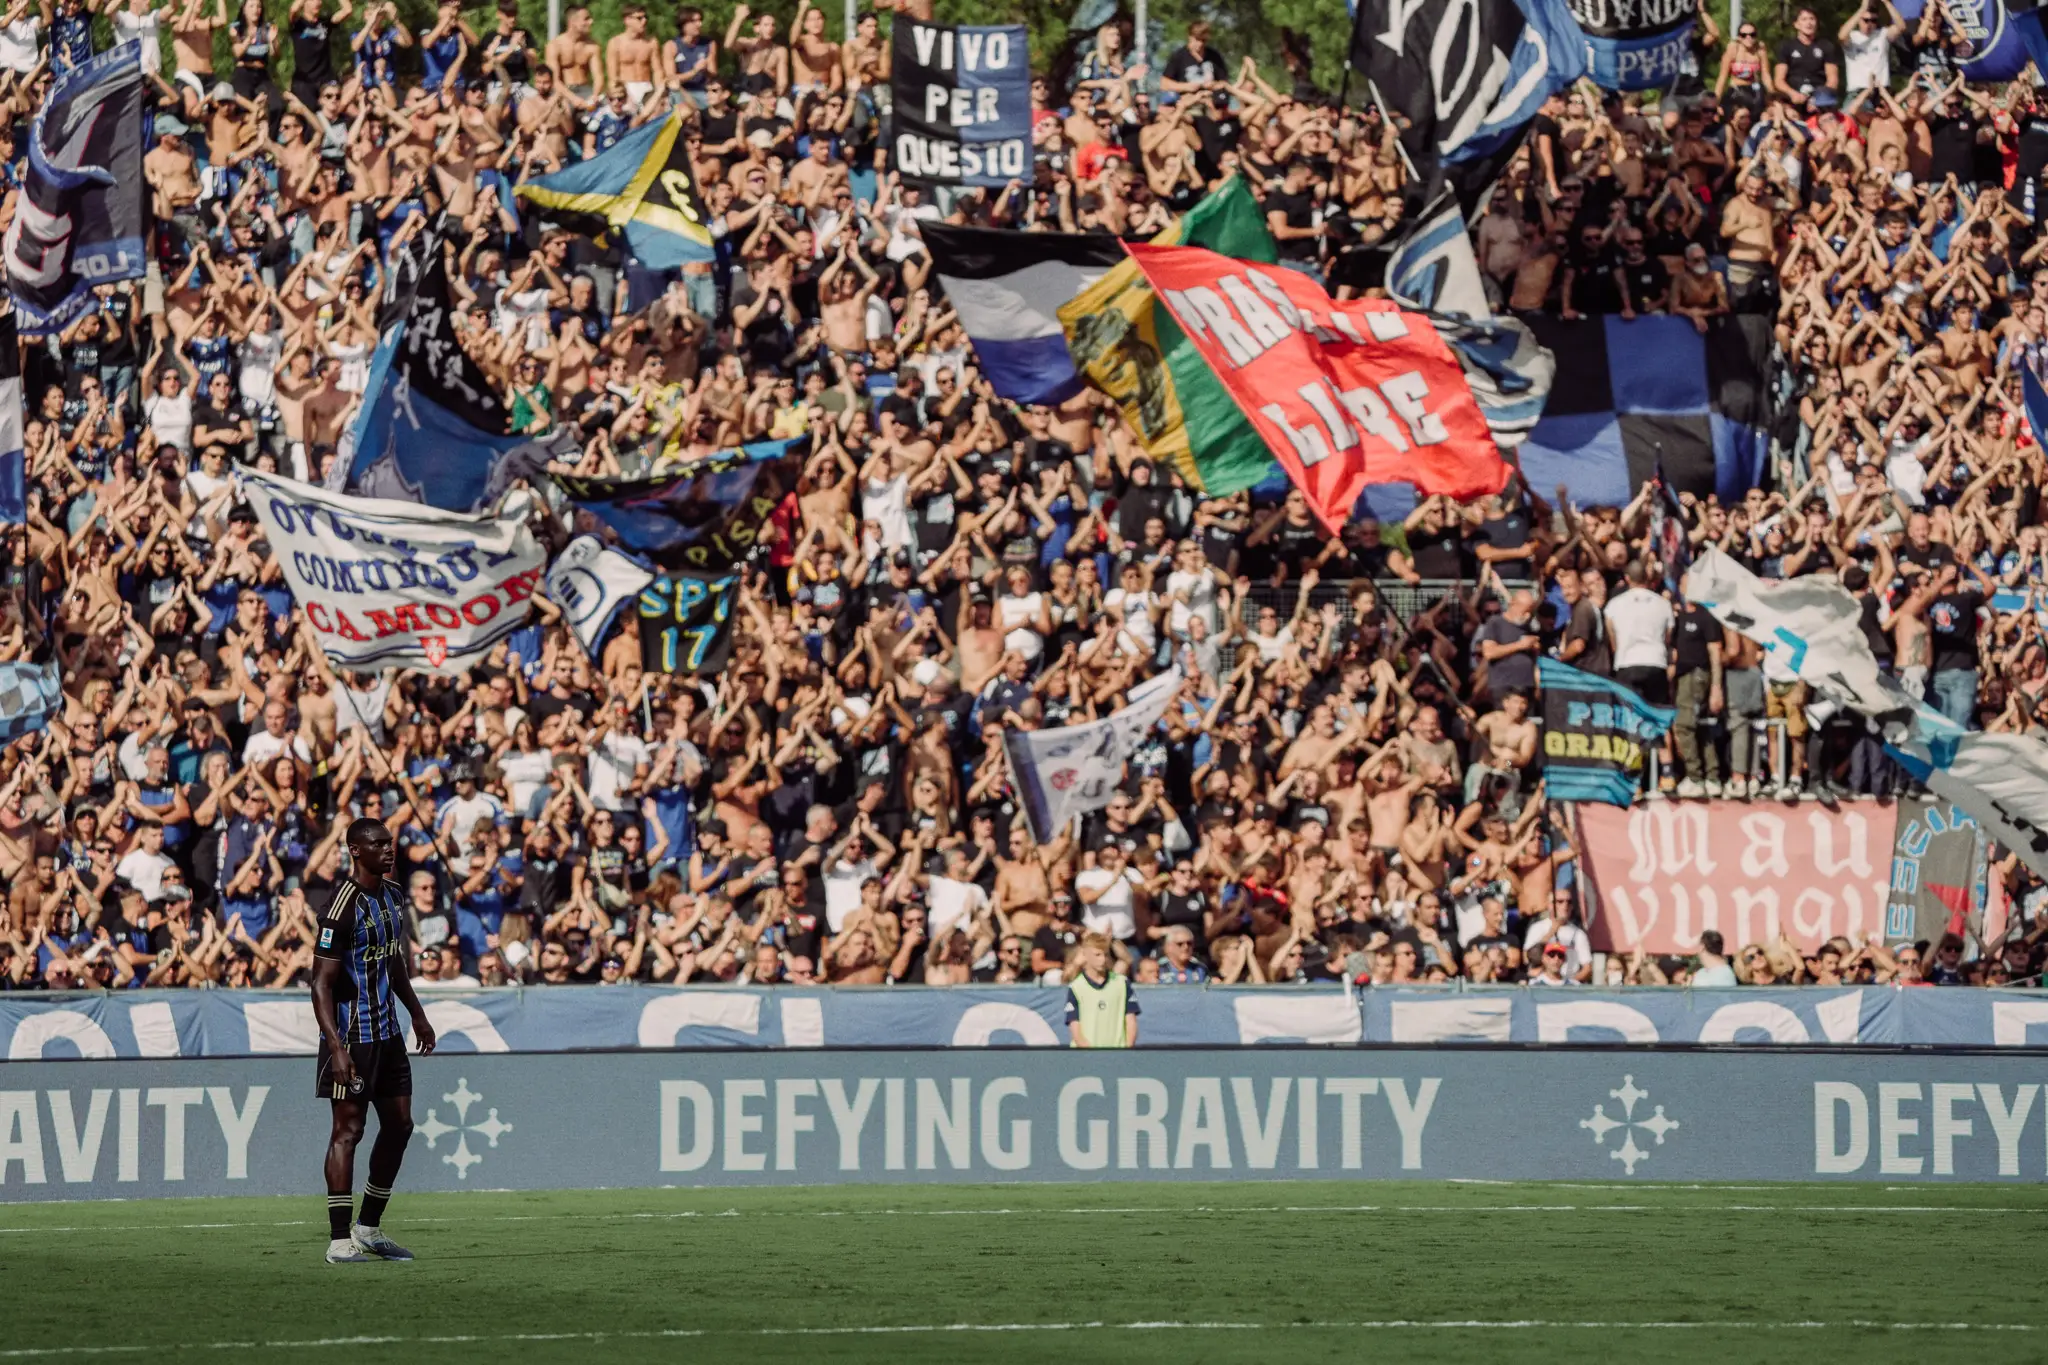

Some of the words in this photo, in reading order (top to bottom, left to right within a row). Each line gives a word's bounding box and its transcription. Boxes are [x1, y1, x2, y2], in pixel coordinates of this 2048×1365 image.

[912, 25, 1010, 72] VIVO
[925, 83, 1001, 127] PER
[896, 133, 1025, 177] QUESTO
[639, 574, 742, 624] SPT
[660, 624, 718, 674] 17
[0, 1086, 272, 1185] AVITY
[659, 1078, 1031, 1172] DEFYING
[1057, 1077, 1443, 1170] GRAVITY
[1813, 1081, 2048, 1177] DEFY
